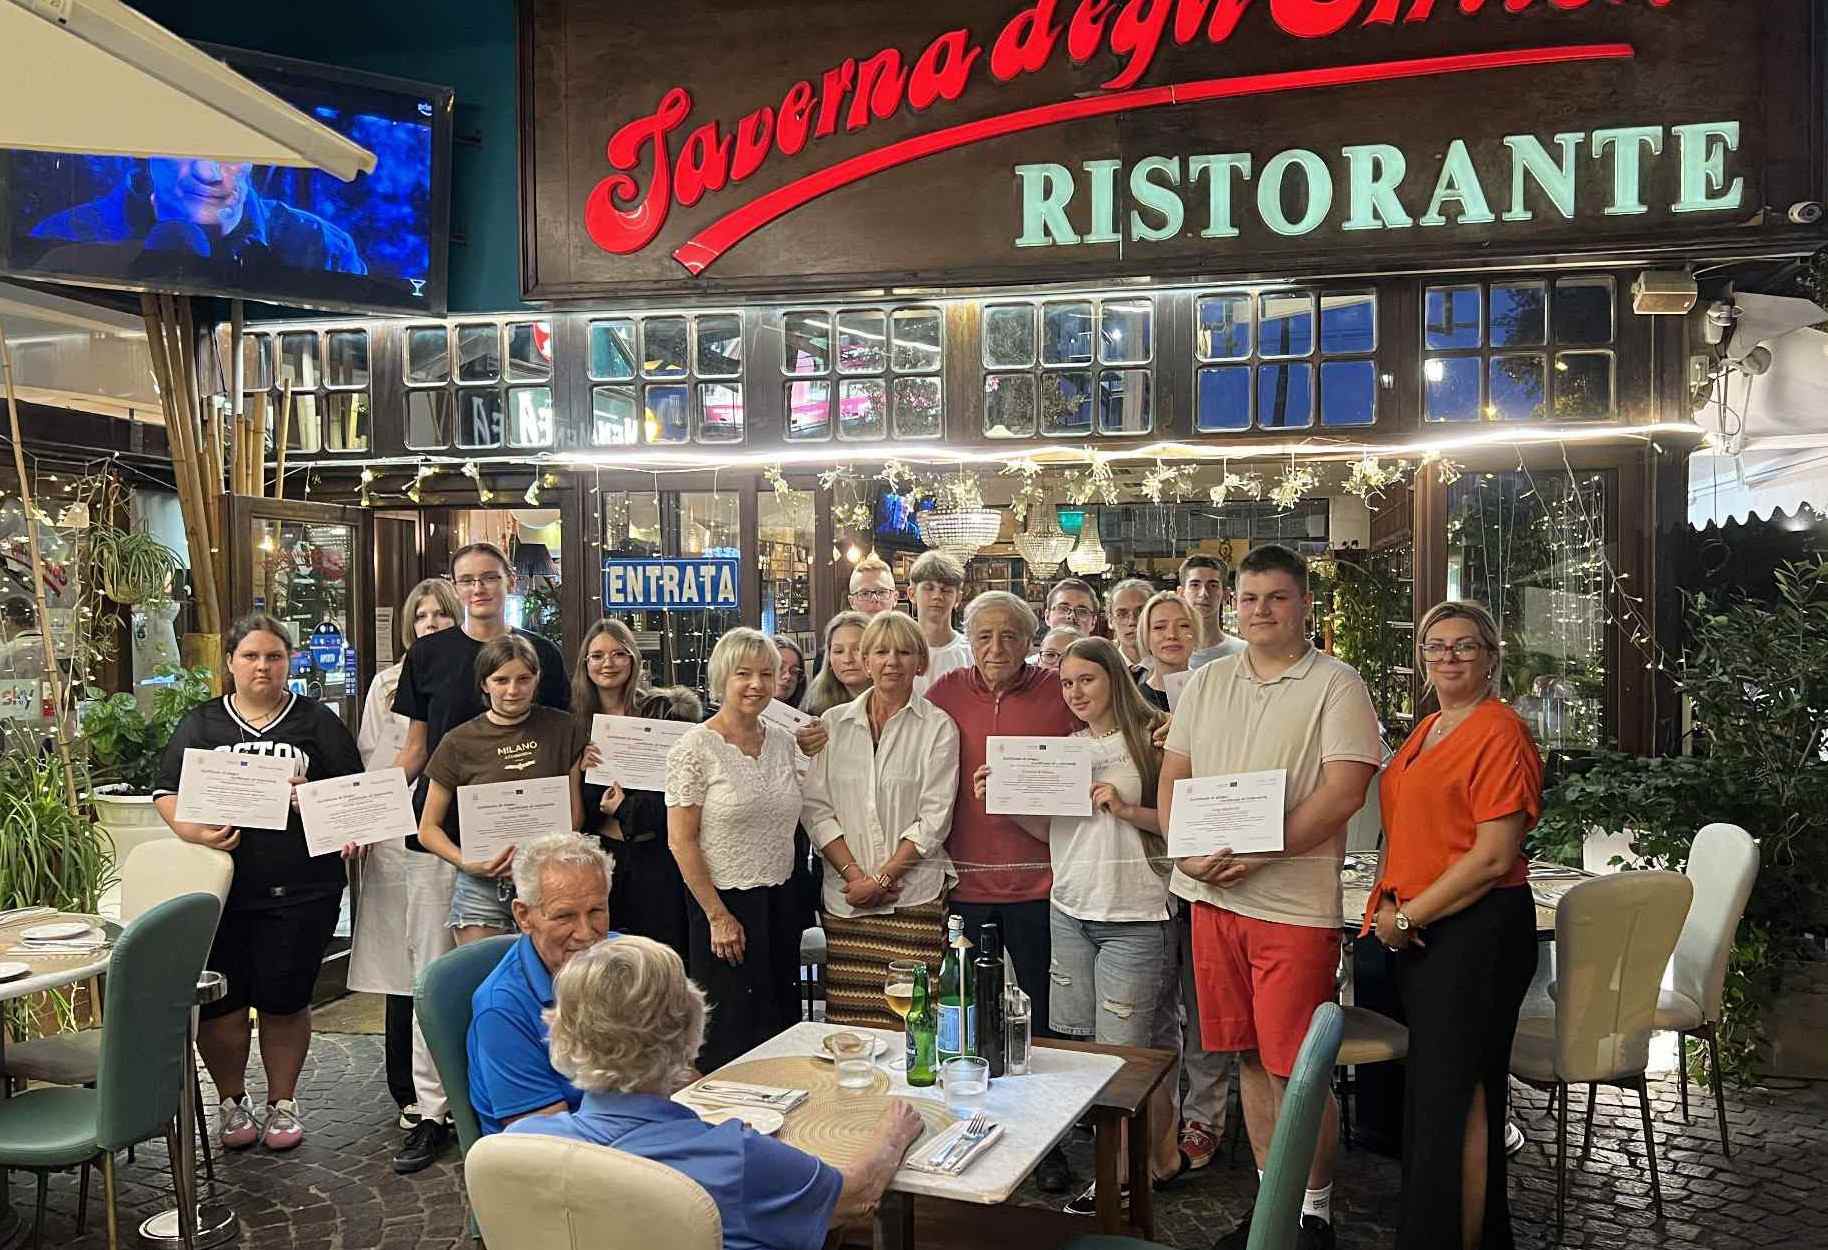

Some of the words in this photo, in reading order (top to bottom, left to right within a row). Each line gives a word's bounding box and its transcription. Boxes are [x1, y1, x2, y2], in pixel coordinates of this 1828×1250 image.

[584, 28, 983, 255] Taverna
[1014, 121, 1744, 249] RISTORANTE
[609, 565, 735, 603] ENTRATA
[497, 741, 538, 756] MILANO
